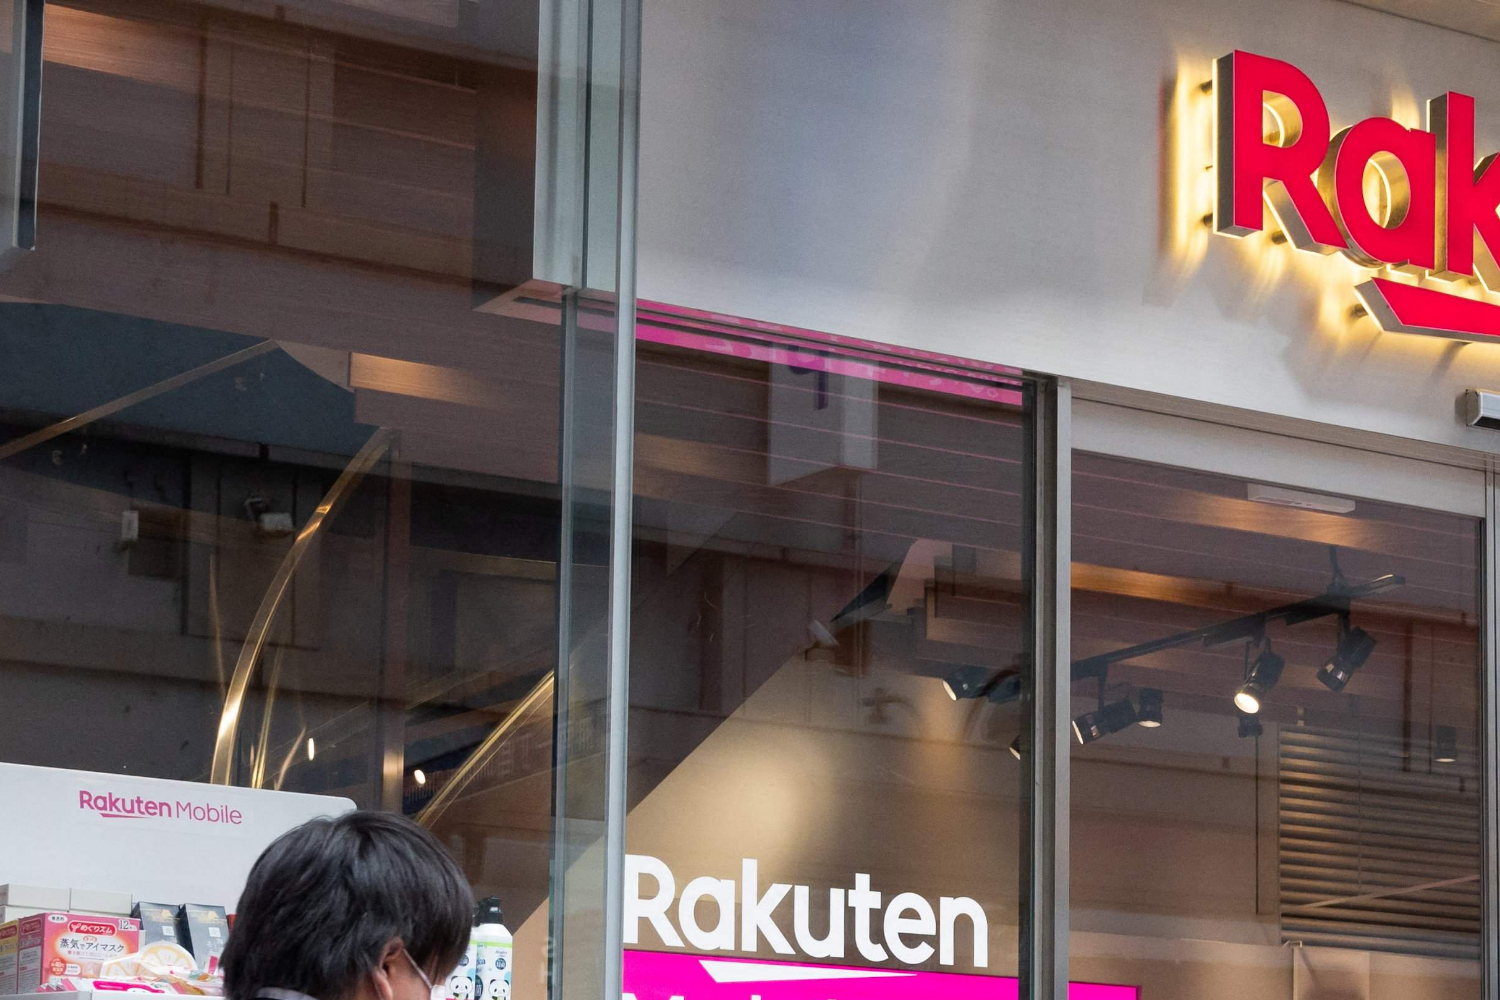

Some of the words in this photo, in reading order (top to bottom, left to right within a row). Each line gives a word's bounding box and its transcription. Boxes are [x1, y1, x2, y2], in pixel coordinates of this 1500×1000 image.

[79, 790, 172, 818] Rakuten
[176, 801, 242, 825] Mobile
[624, 854, 989, 974] Rakuten
[60, 939, 125, 953] 蒸気でアイマスク
